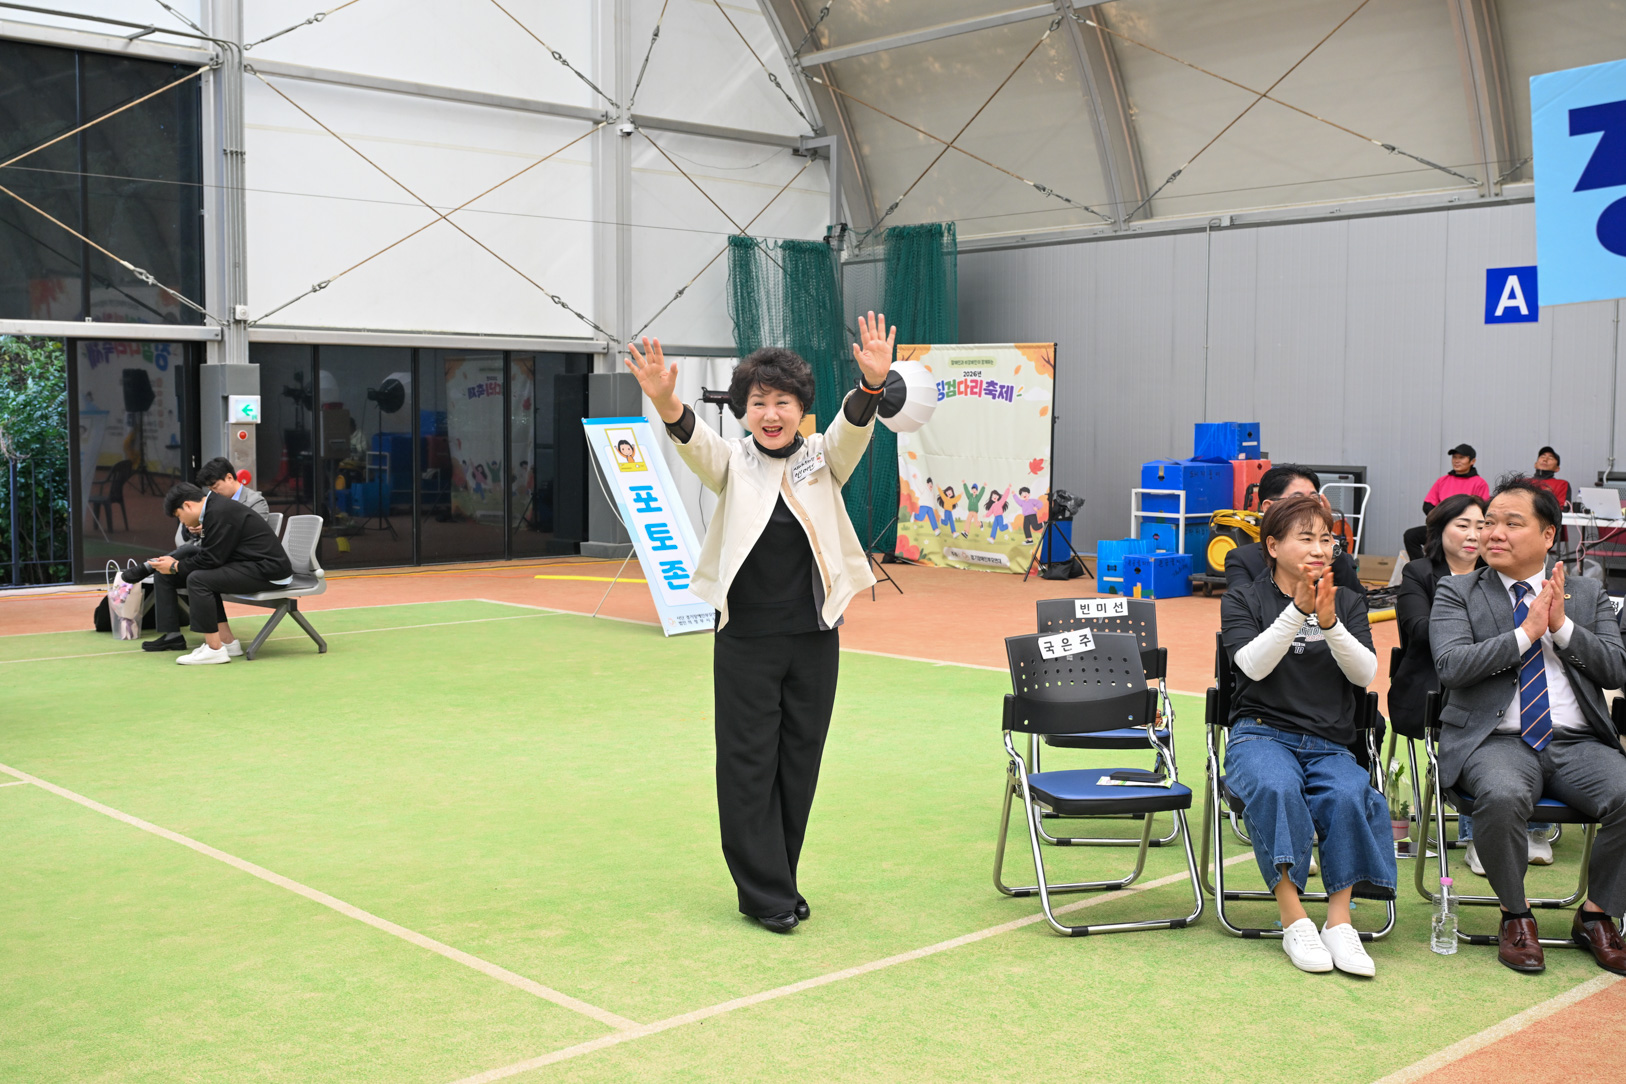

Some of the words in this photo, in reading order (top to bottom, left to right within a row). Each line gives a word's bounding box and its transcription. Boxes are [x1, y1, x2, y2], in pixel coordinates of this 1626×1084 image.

[1494, 275, 1529, 316] A
[628, 485, 690, 591] 포토존
[1079, 602, 1124, 615] 빈미선
[1043, 633, 1092, 655] 국은주
